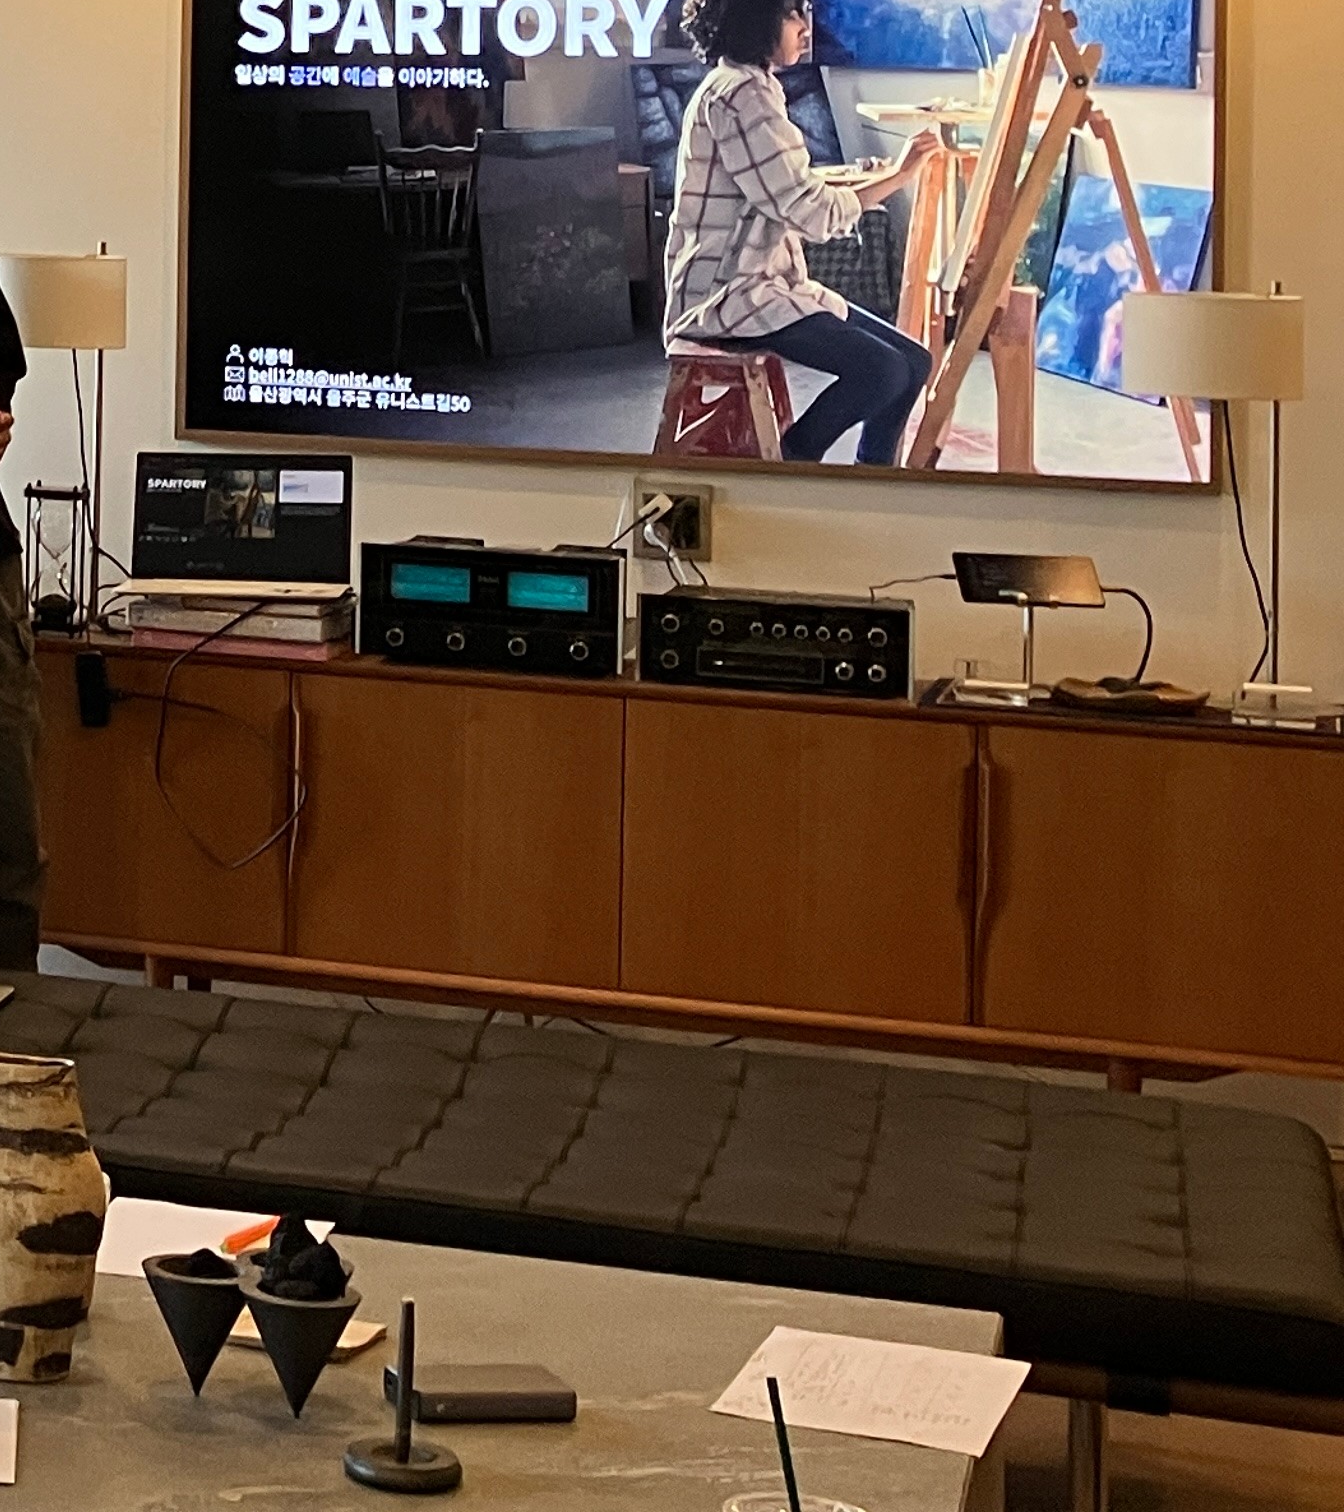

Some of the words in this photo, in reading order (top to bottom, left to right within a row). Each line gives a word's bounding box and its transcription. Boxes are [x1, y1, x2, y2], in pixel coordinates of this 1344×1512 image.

[234, 63, 286, 86] 일상의
[289, 65, 339, 87] 공간에
[343, 65, 394, 88] 예술을
[398, 66, 490, 89] 이야기하다.
[248, 385, 322, 407] 울산광역시
[326, 389, 372, 410] 울주군
[375, 391, 472, 413] 유니스트길50
[147, 478, 207, 489] SPARTORY
